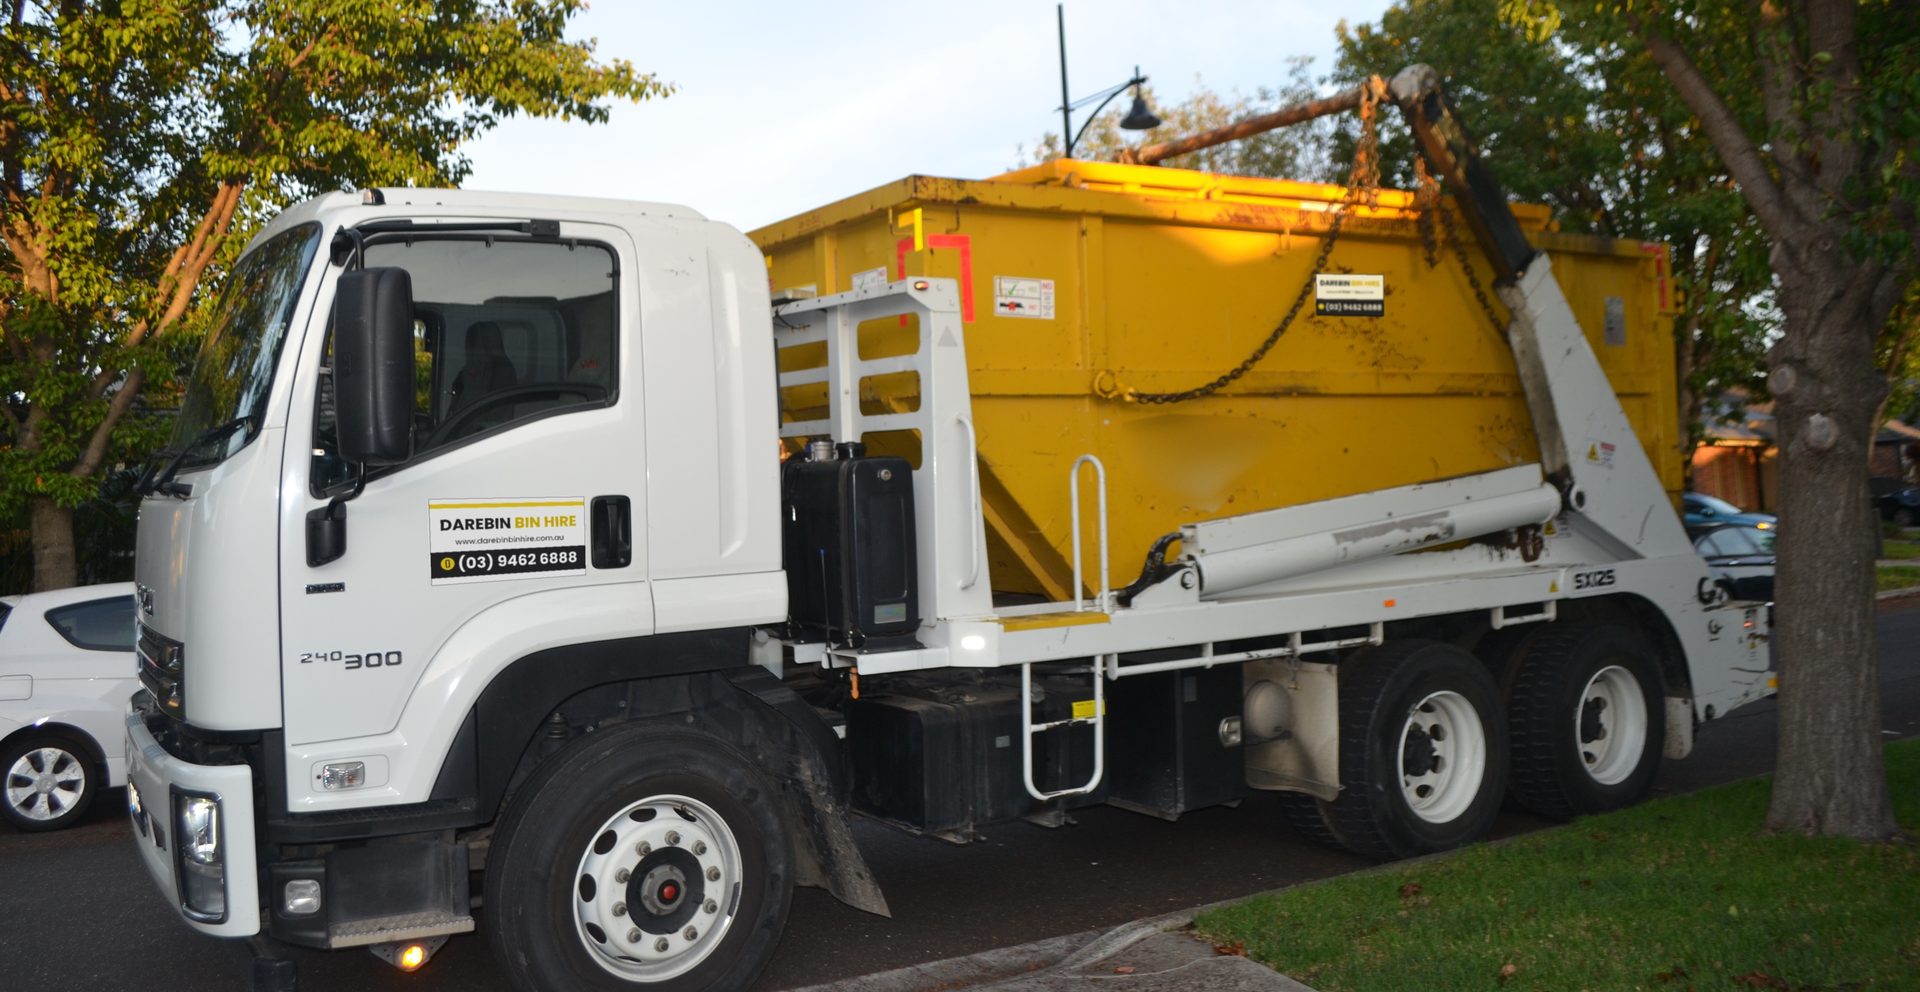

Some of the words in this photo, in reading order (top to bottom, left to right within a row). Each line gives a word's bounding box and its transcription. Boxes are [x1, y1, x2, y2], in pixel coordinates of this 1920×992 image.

[1319, 279, 1351, 287] DAREBIN
[440, 517, 511, 531] DAREBIN
[515, 516, 541, 529] BIN
[544, 515, 577, 528] HIRE
[455, 535, 565, 545] www.darebinbinhire.com.au
[458, 553, 494, 572] (03)
[497, 553, 537, 567] 9462
[539, 551, 578, 564] 6888
[300, 650, 342, 664] 240
[344, 650, 403, 670] 300
